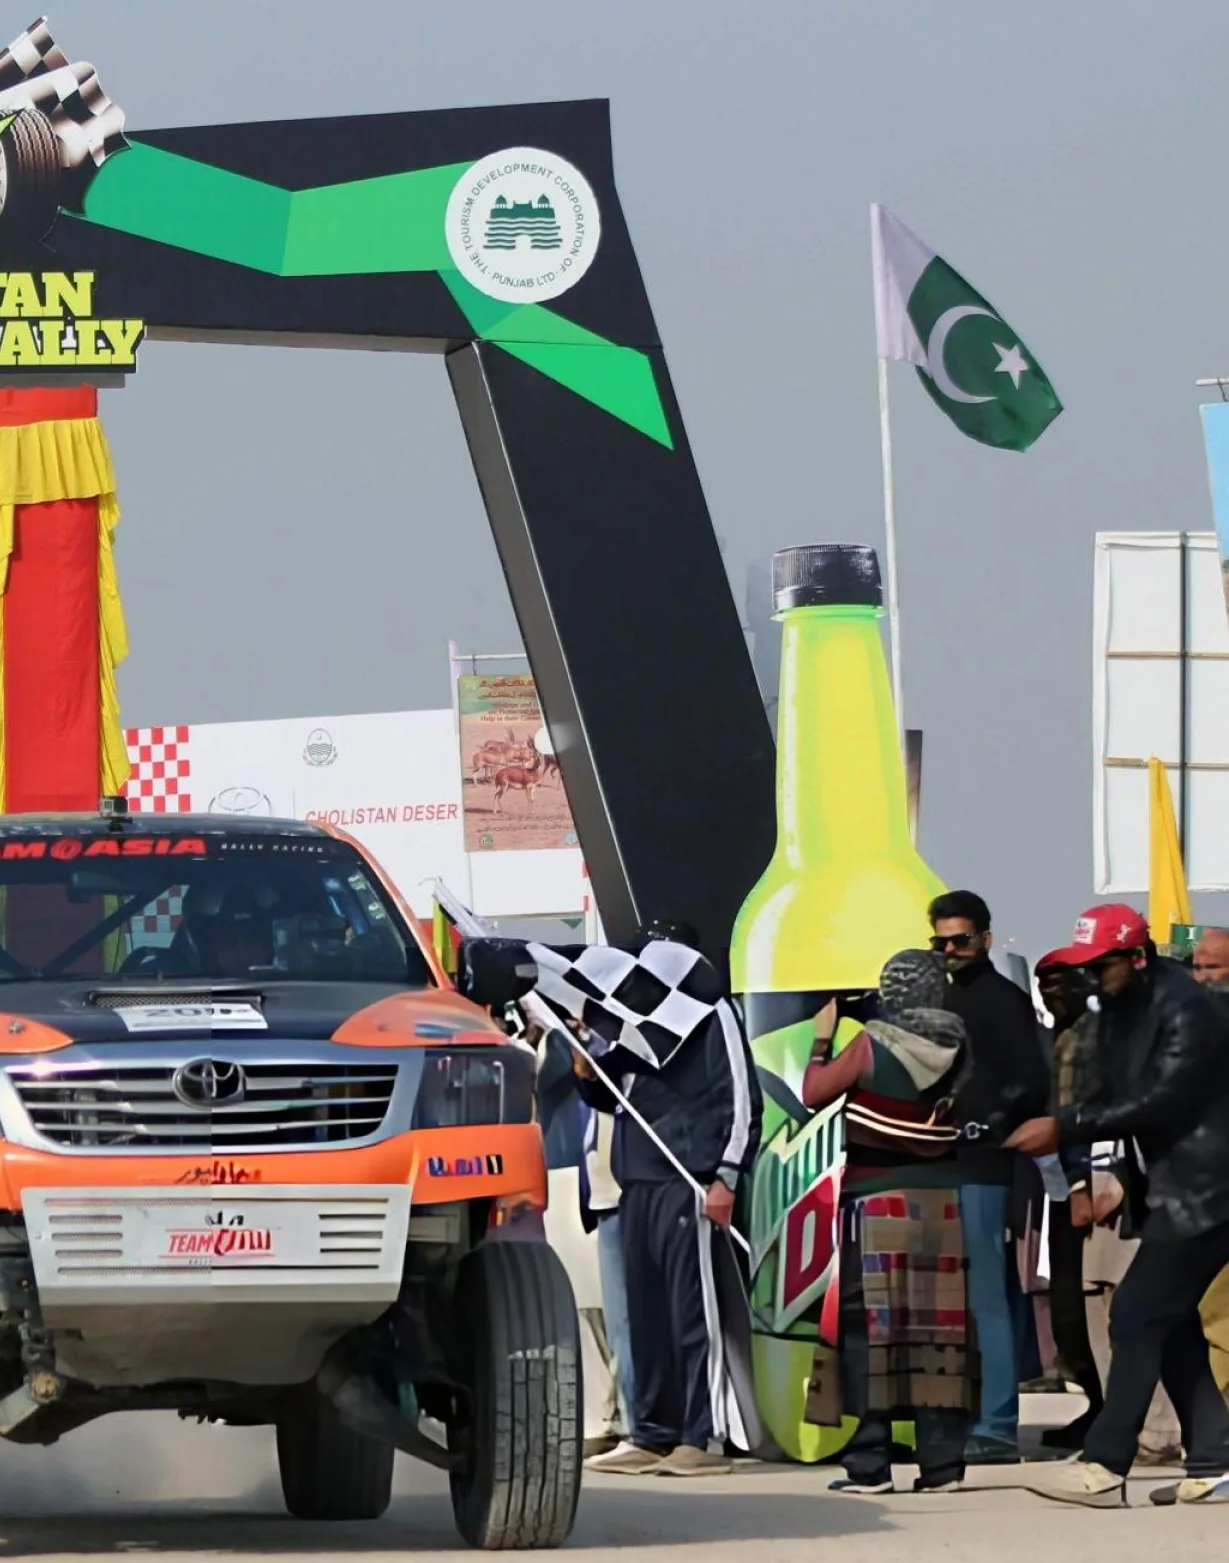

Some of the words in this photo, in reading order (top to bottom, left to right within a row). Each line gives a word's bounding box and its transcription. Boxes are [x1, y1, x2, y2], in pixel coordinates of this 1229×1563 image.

[471, 163, 555, 197] DEVELOPMENT
[460, 199, 474, 252] TOURISM
[554, 175, 586, 257] CORPORATION
[469, 252, 489, 275] THE
[560, 257, 573, 272] OF
[491, 272, 535, 288] PUNJAB
[536, 271, 556, 285] LTD
[403, 804, 460, 821] DESER
[84, 838, 207, 857] ASIA
[168, 1234, 212, 1253] TEAM
